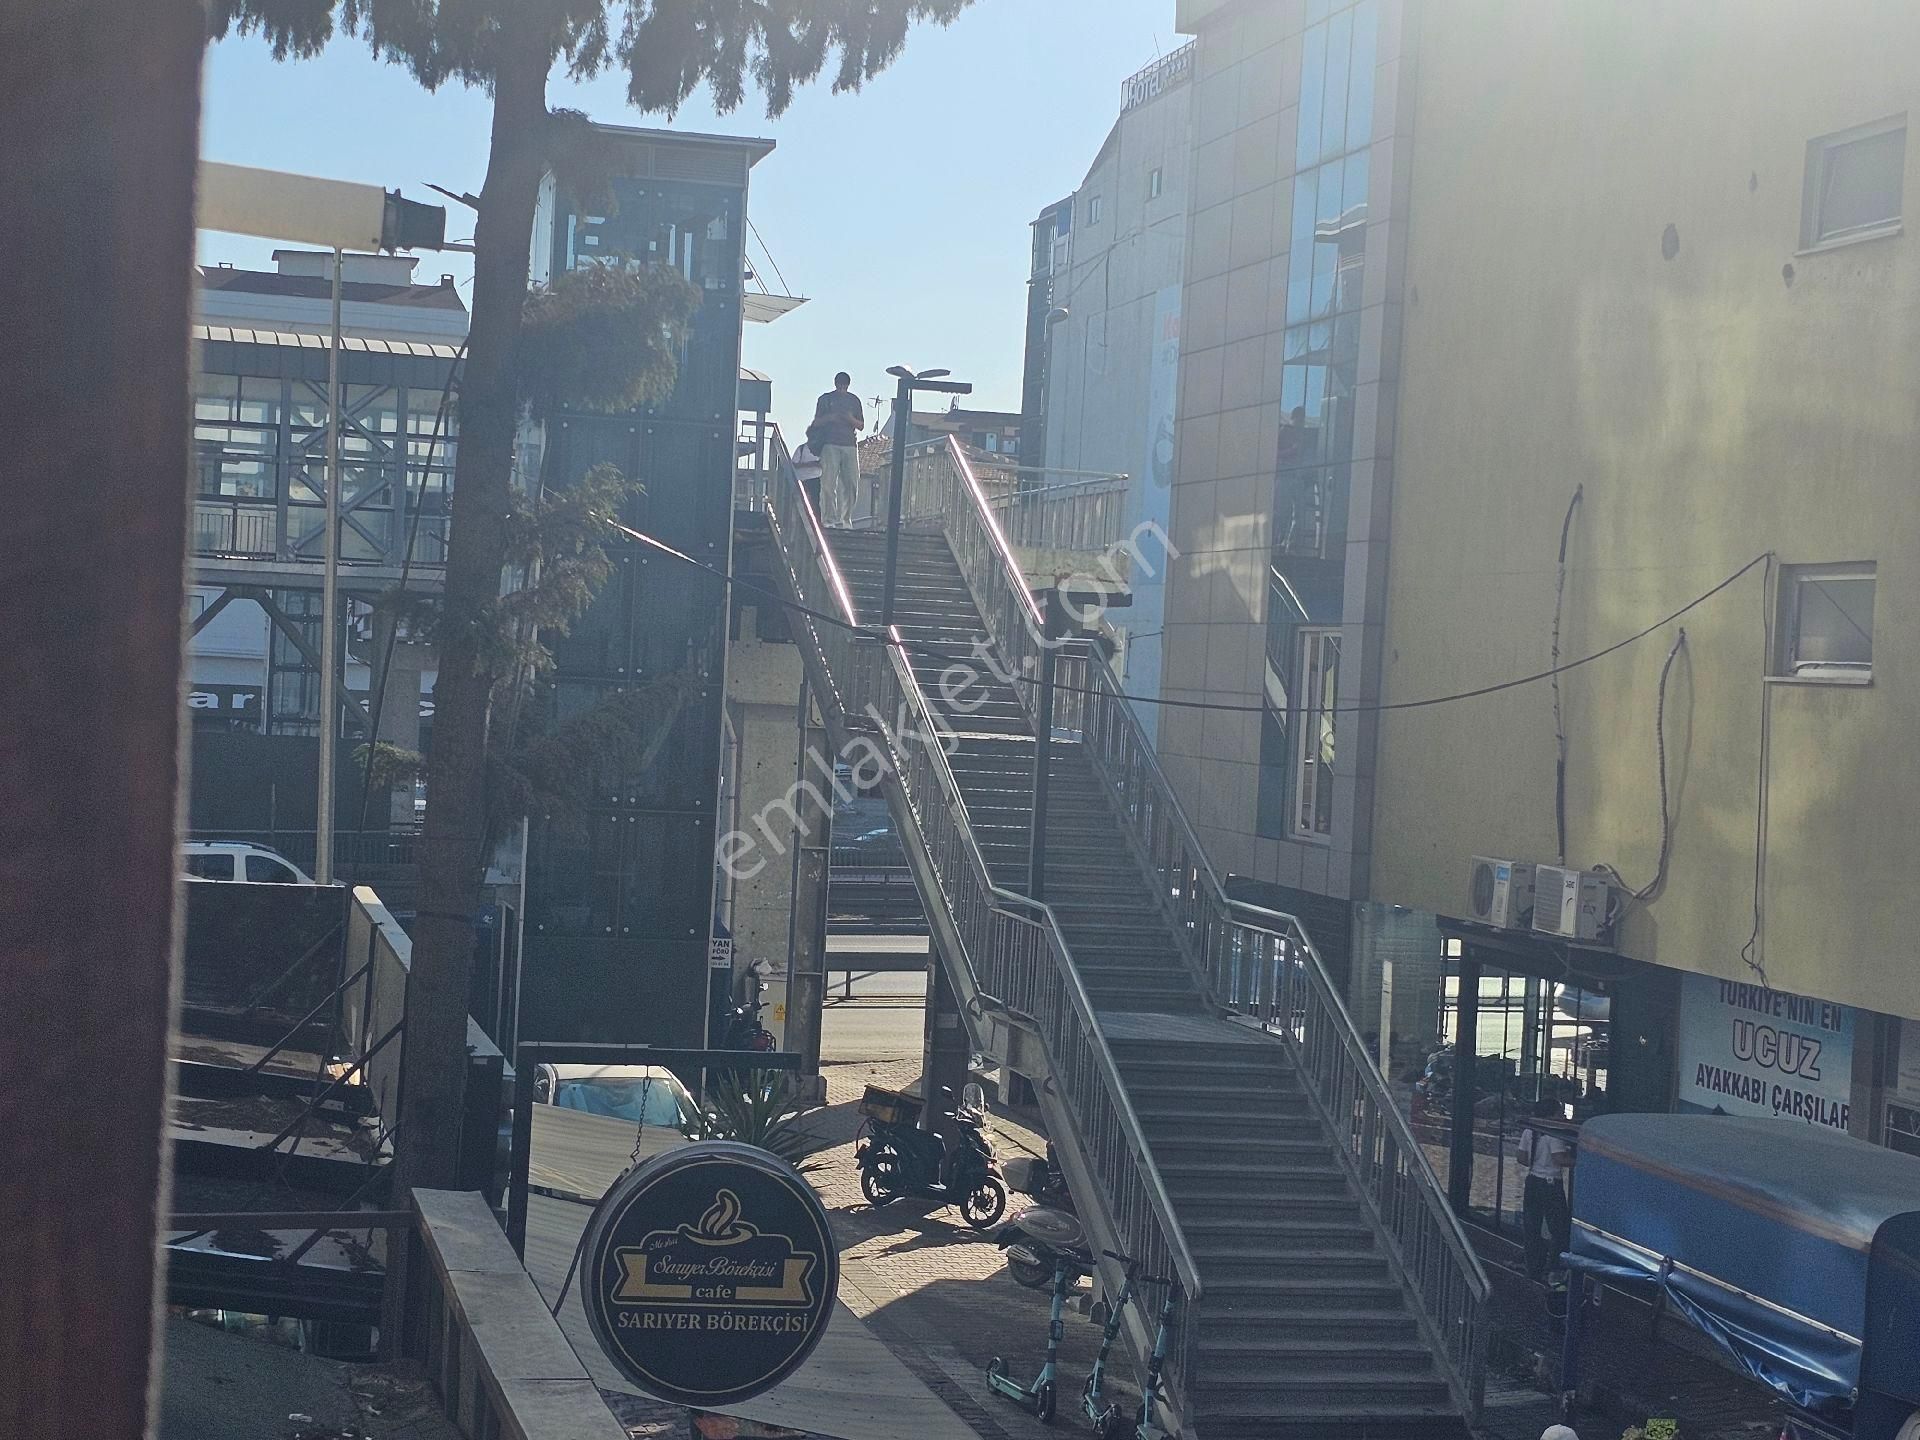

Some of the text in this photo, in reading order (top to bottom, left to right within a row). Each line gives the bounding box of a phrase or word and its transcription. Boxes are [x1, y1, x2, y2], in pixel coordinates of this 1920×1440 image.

[1129, 72, 1161, 109] HOTEL
[1821, 1002, 1842, 1033] EN
[1732, 1019, 1822, 1081] UCUZ
[1695, 1063, 1767, 1106] AYAKKABI
[696, 1284, 732, 1298] cafe
[618, 1311, 808, 1335] SARIYER BÖREKÇİSİ
